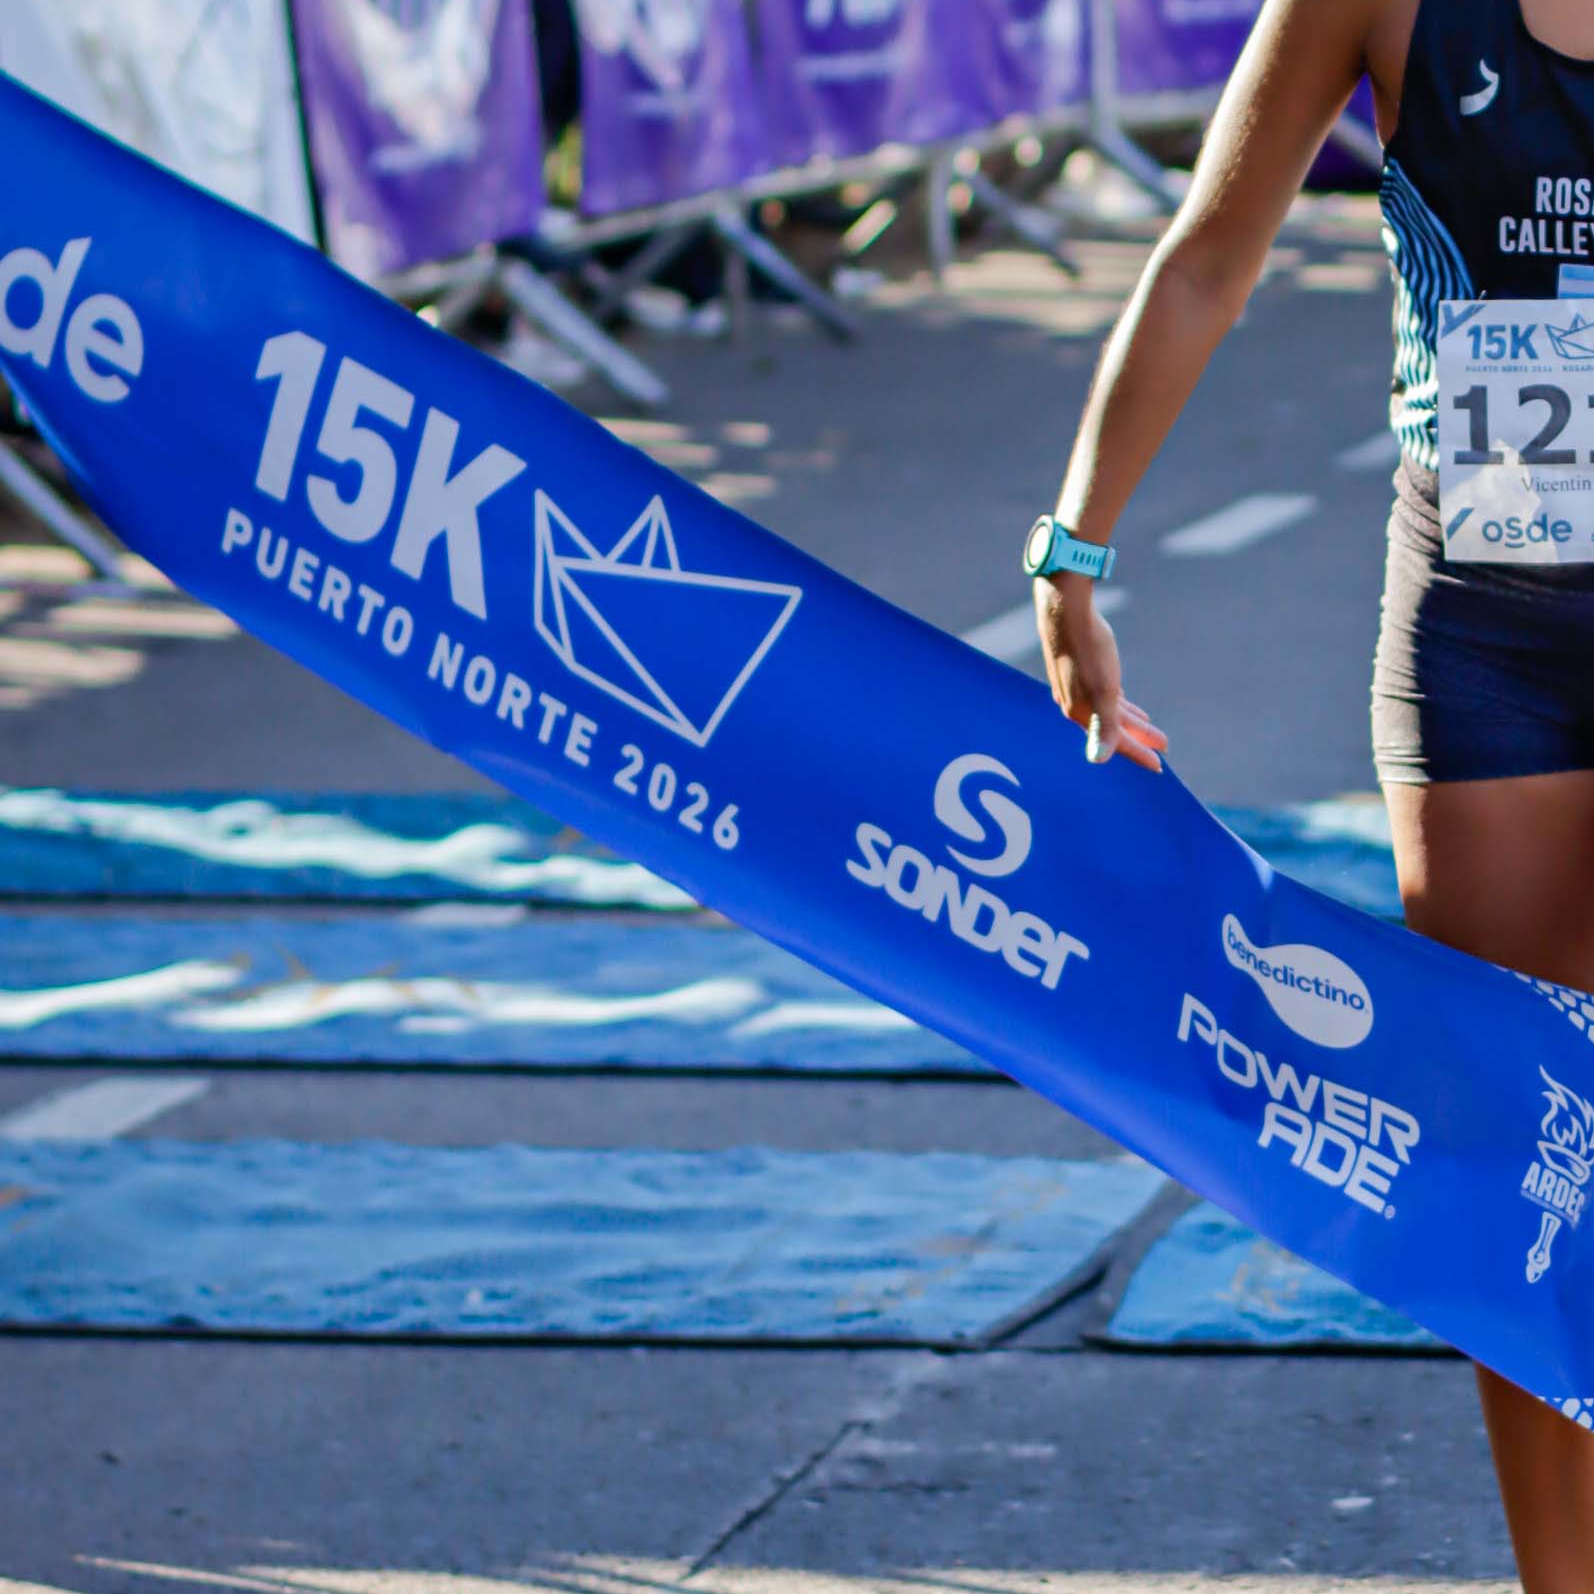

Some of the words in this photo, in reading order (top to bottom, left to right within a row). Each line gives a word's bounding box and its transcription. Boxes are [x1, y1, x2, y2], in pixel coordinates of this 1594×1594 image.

[0, 237, 143, 402] de
[1466, 323, 1539, 360] 15K
[255, 331, 527, 620] 15K
[1482, 513, 1573, 547] osde
[1521, 477, 1592, 492] Vicentin
[222, 509, 413, 655] PUERTO
[428, 633, 597, 766] NORTE
[613, 744, 739, 850] 2026
[1227, 923, 1365, 1011] benedictino
[1177, 992, 1421, 1165] POWER
[1257, 1102, 1401, 1214] ADE
